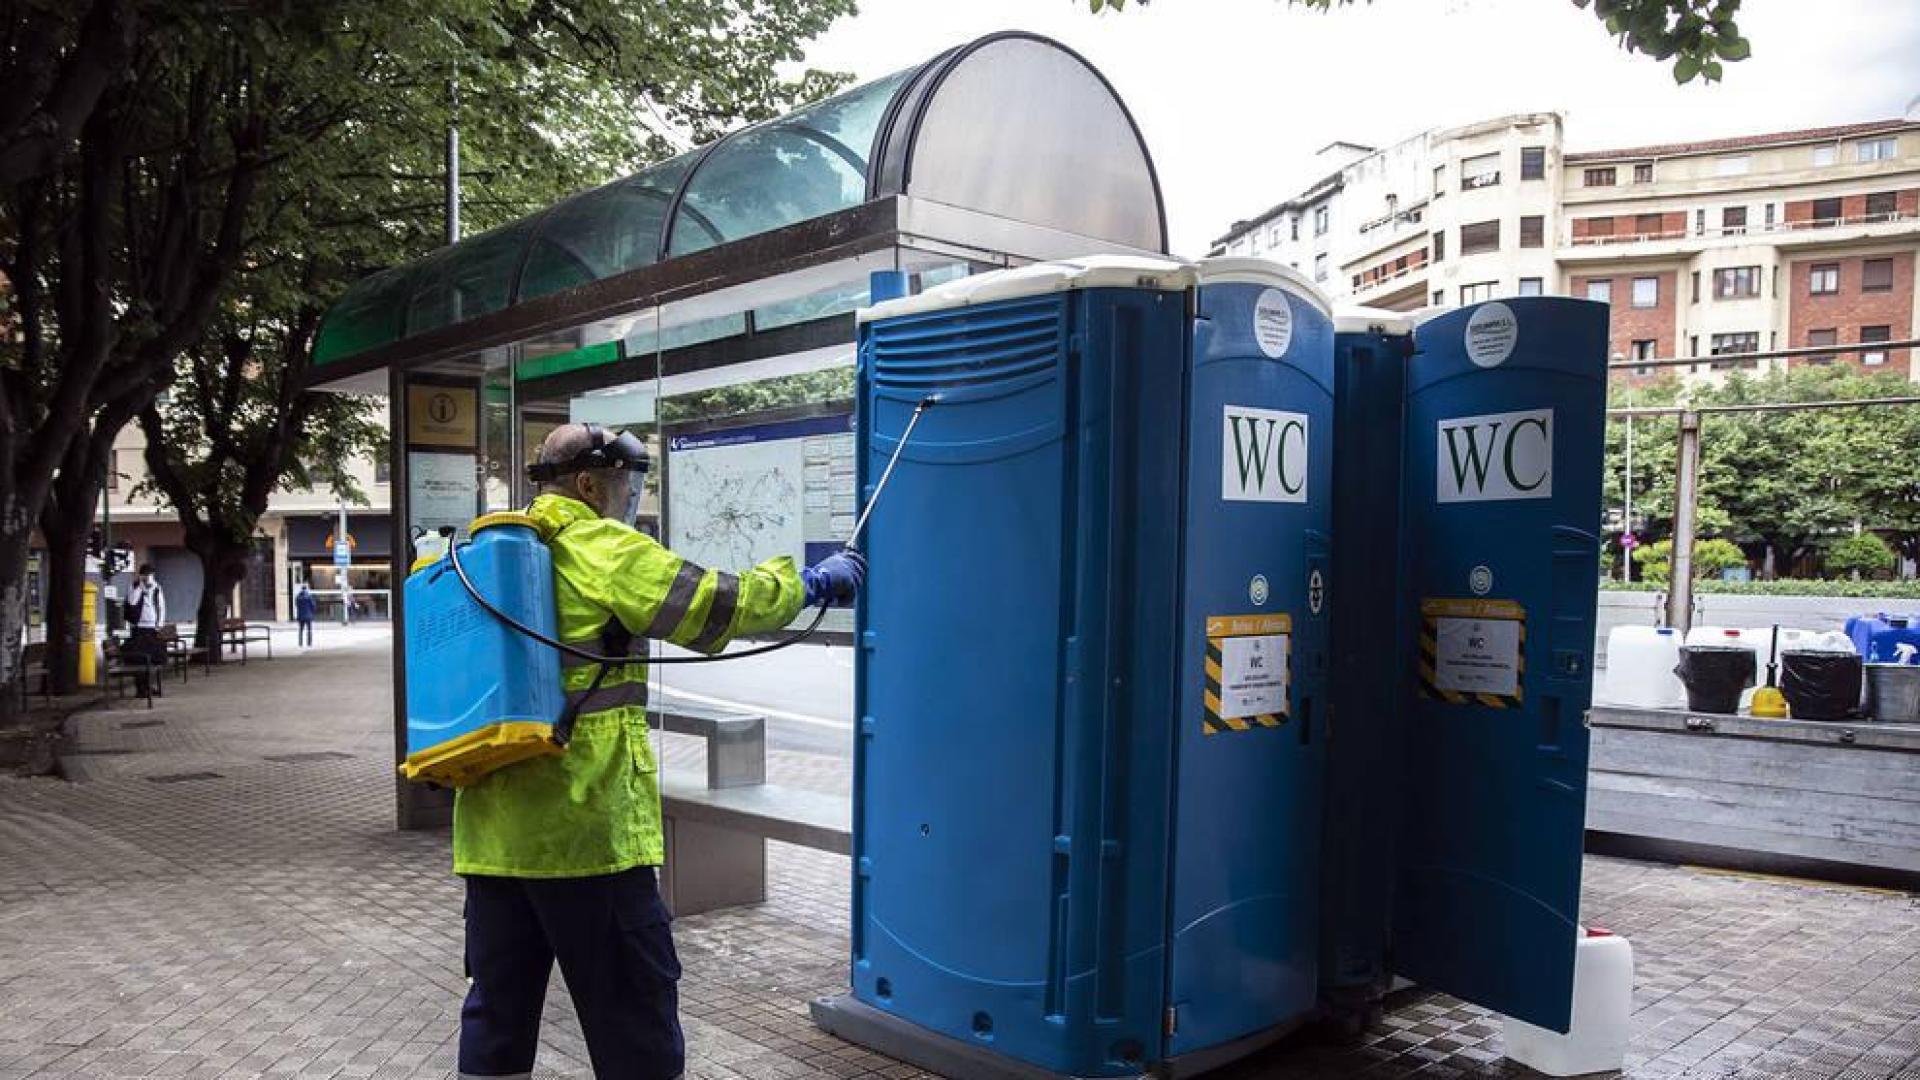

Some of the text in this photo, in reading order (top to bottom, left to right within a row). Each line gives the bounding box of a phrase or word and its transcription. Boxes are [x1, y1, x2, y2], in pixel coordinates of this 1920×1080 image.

[1228, 415, 1304, 495] WC
[1443, 417, 1548, 494] WC
[1249, 655, 1264, 668] WC
[1468, 636, 1485, 649] WC
